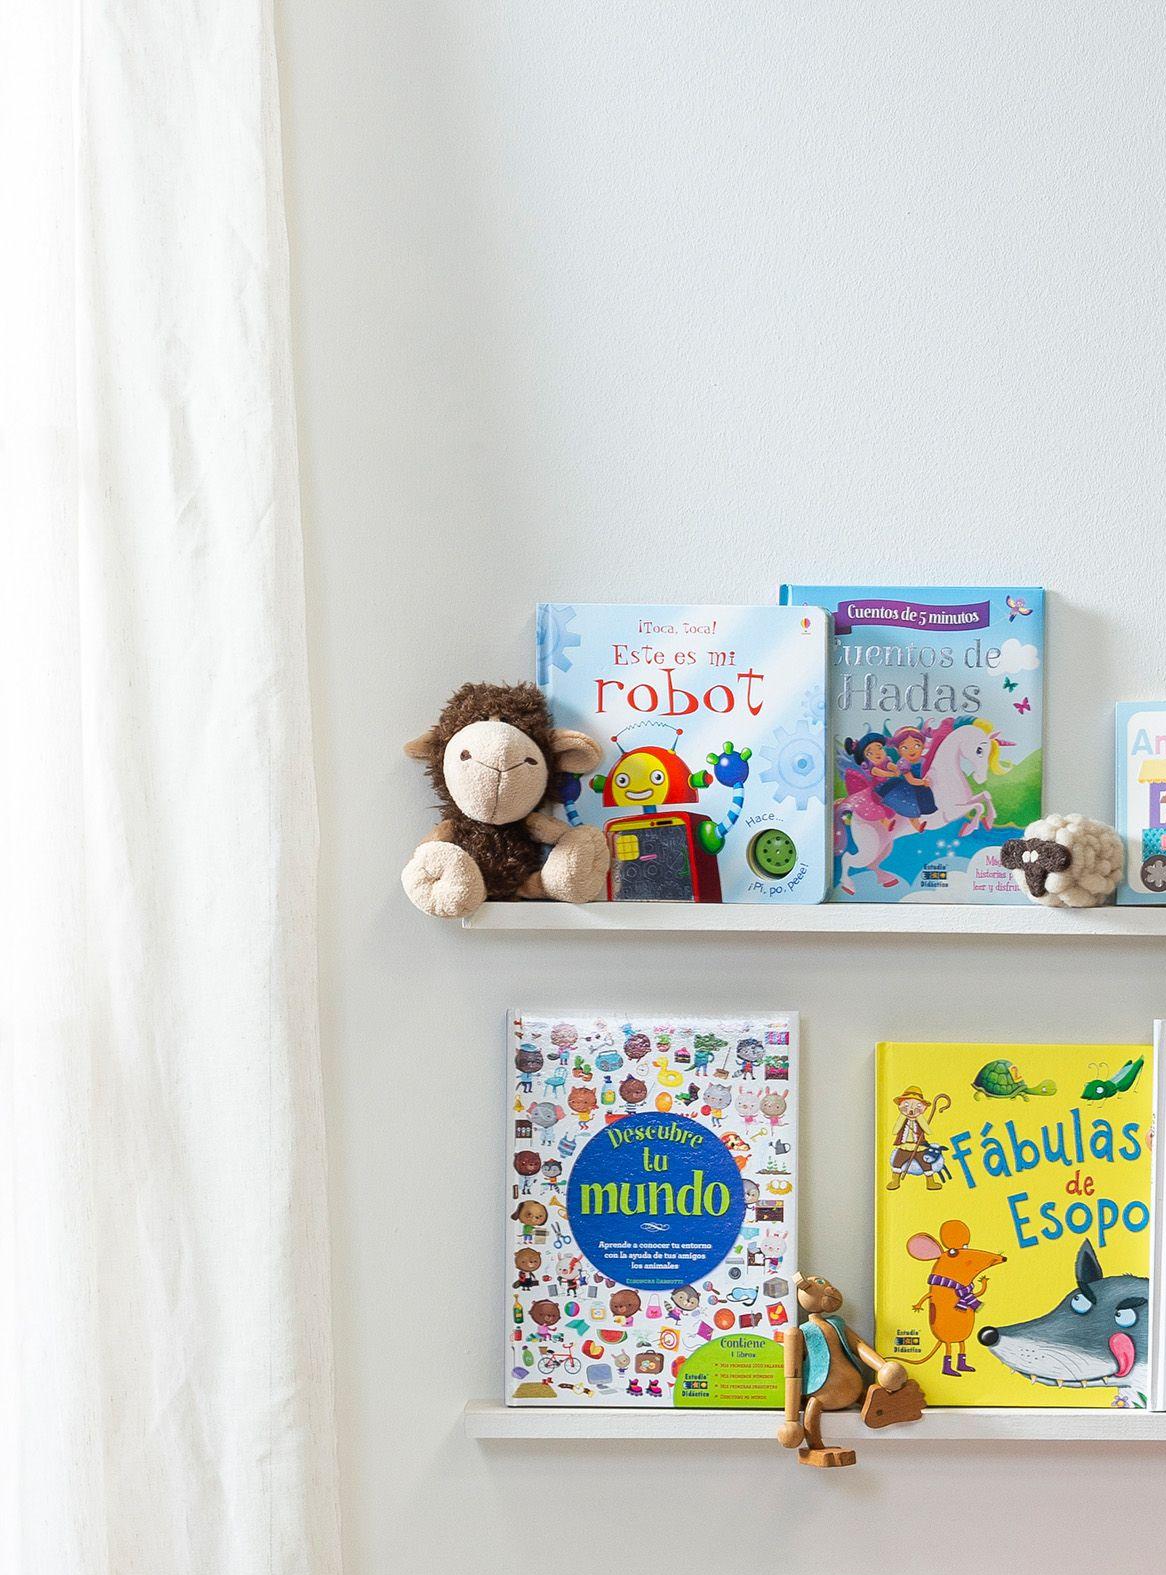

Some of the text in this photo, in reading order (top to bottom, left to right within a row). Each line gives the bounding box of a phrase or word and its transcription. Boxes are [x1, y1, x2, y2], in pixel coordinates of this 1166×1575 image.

[847, 604, 980, 626] Cuentos de 5 minutos
[611, 644, 737, 666] Este es mi
[964, 638, 1001, 668] de
[594, 668, 765, 717] robot
[837, 672, 981, 713] Hadas
[606, 1122, 704, 1149] Descubre
[950, 1108, 1141, 1189] Fábulas
[643, 1146, 669, 1172] tu
[580, 1170, 731, 1217] mundo
[1066, 1170, 1095, 1196] de
[1007, 1192, 1149, 1248] Esopo
[598, 1241, 632, 1250] Aprende
[619, 1251, 627, 1259] la
[628, 1252, 652, 1261] ayuda
[677, 1252, 706, 1261] amigos
[643, 1262, 680, 1270] animales
[720, 1337, 766, 1348] Contiene
